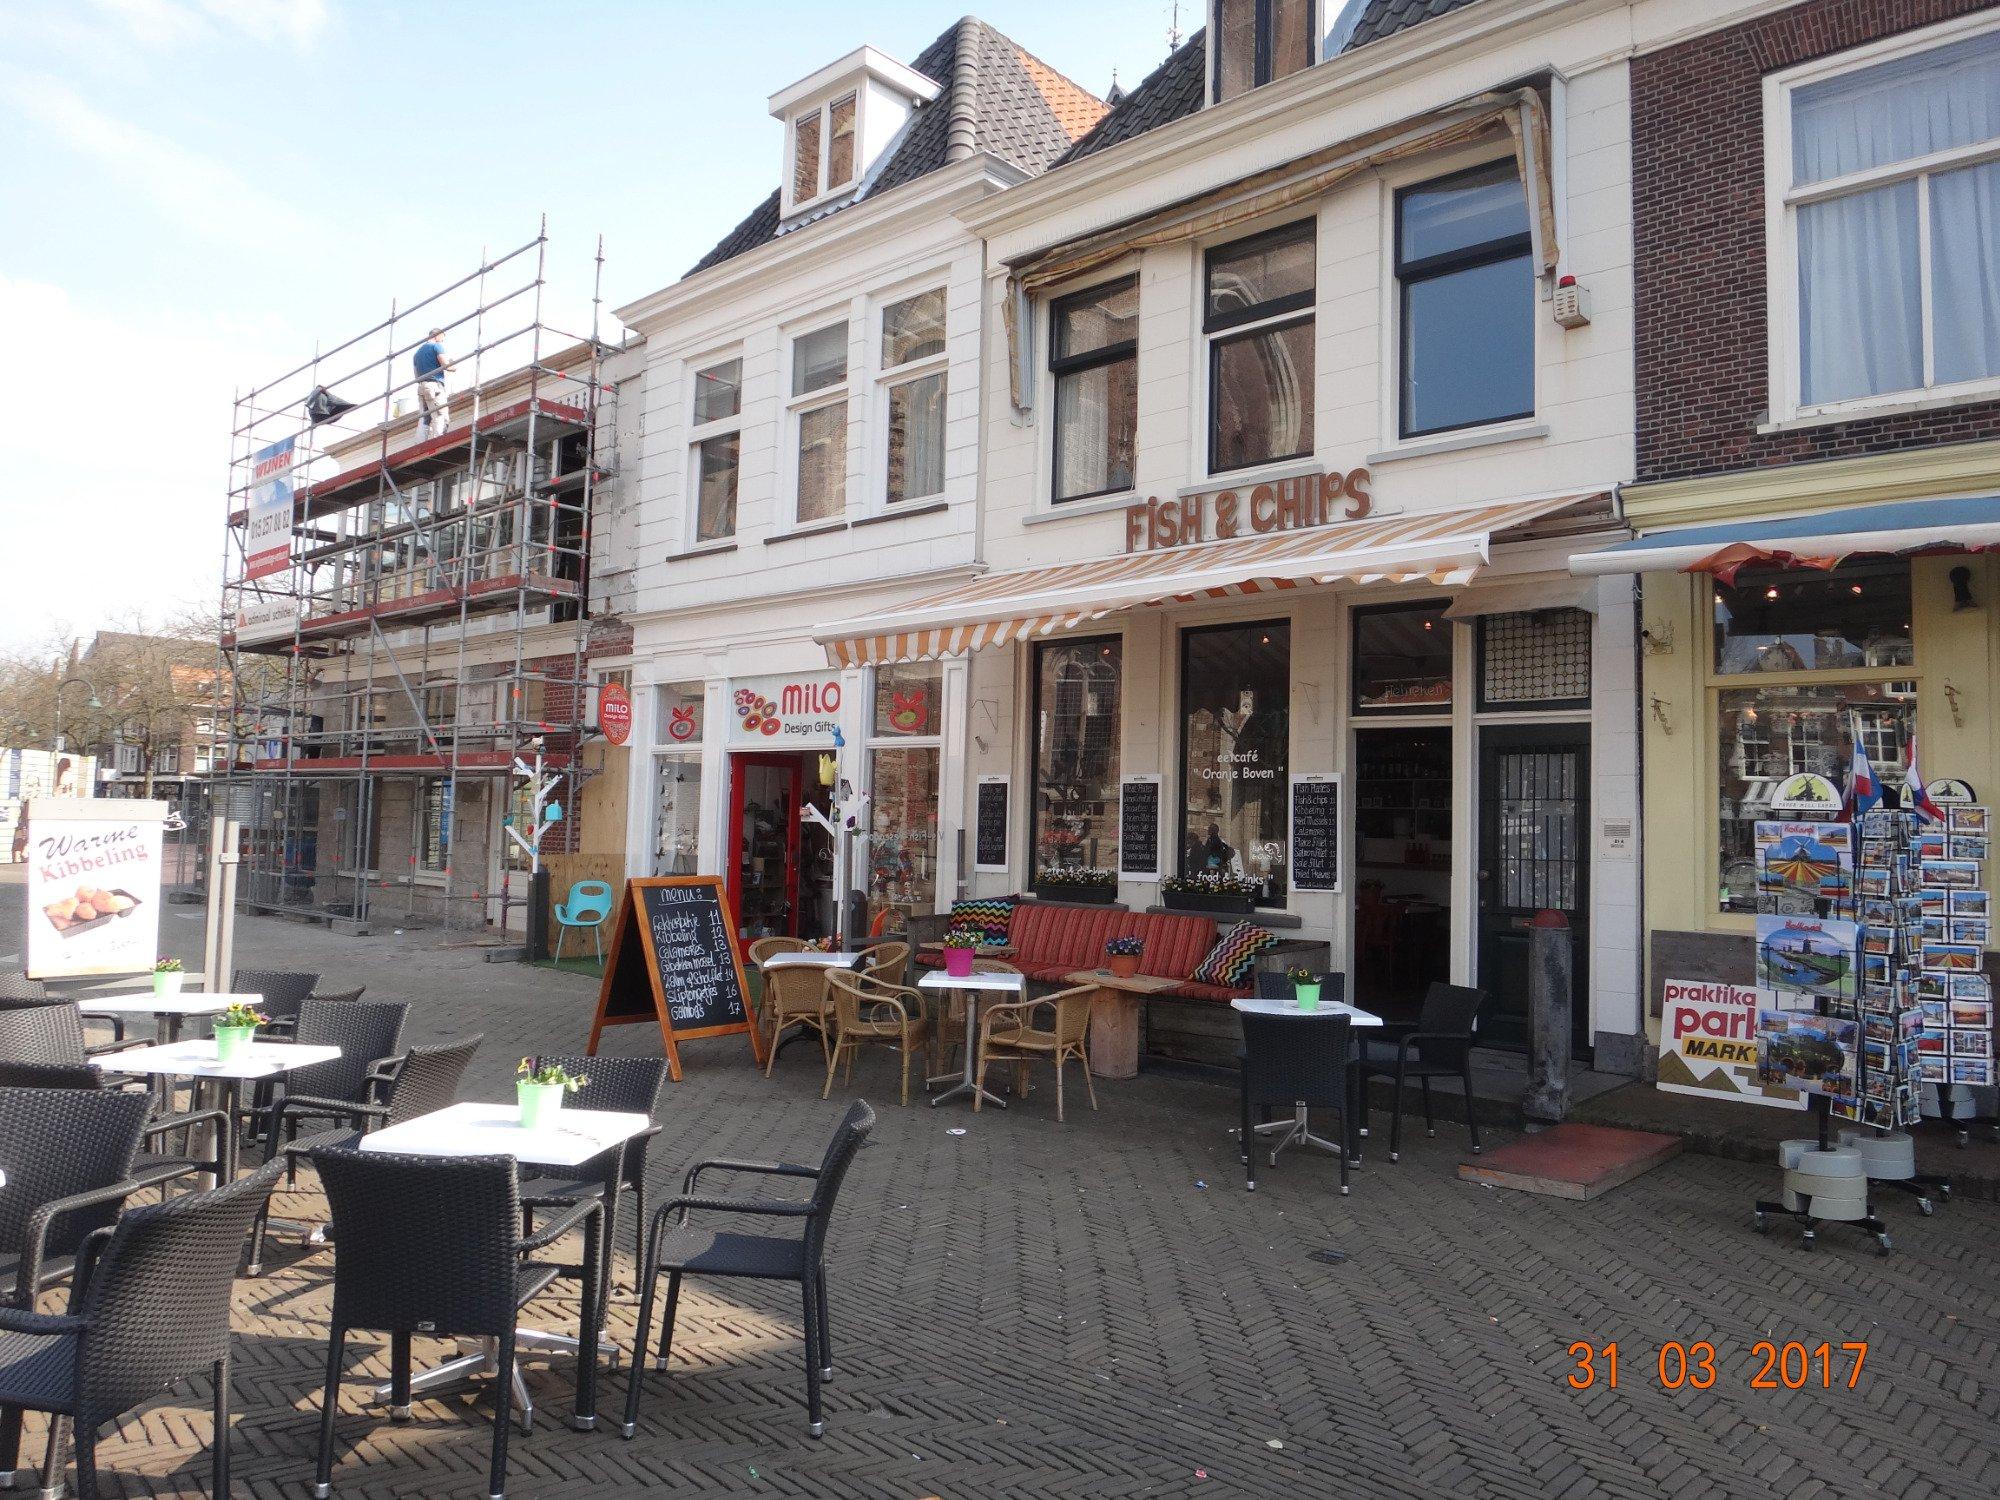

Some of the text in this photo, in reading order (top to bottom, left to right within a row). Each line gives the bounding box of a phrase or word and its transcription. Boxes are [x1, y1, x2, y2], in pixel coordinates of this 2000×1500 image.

[1215, 490, 1238, 538] &
[1251, 467, 1372, 532] CHIPS
[784, 721, 836, 735] Design Gifts
[1217, 749, 1259, 762] eetcafé
[1202, 767, 1239, 782] Oranje
[1242, 767, 1274, 779] Boven
[38, 825, 138, 859] Warme
[39, 843, 149, 883] Kibbeling
[708, 909, 722, 925] 11
[711, 926, 725, 939] 12
[714, 939, 727, 951] 13
[718, 952, 731, 964] 13
[725, 968, 734, 981] 14
[725, 983, 738, 999] 16
[1665, 984, 1757, 1007] praktika
[728, 1001, 741, 1015] 17
